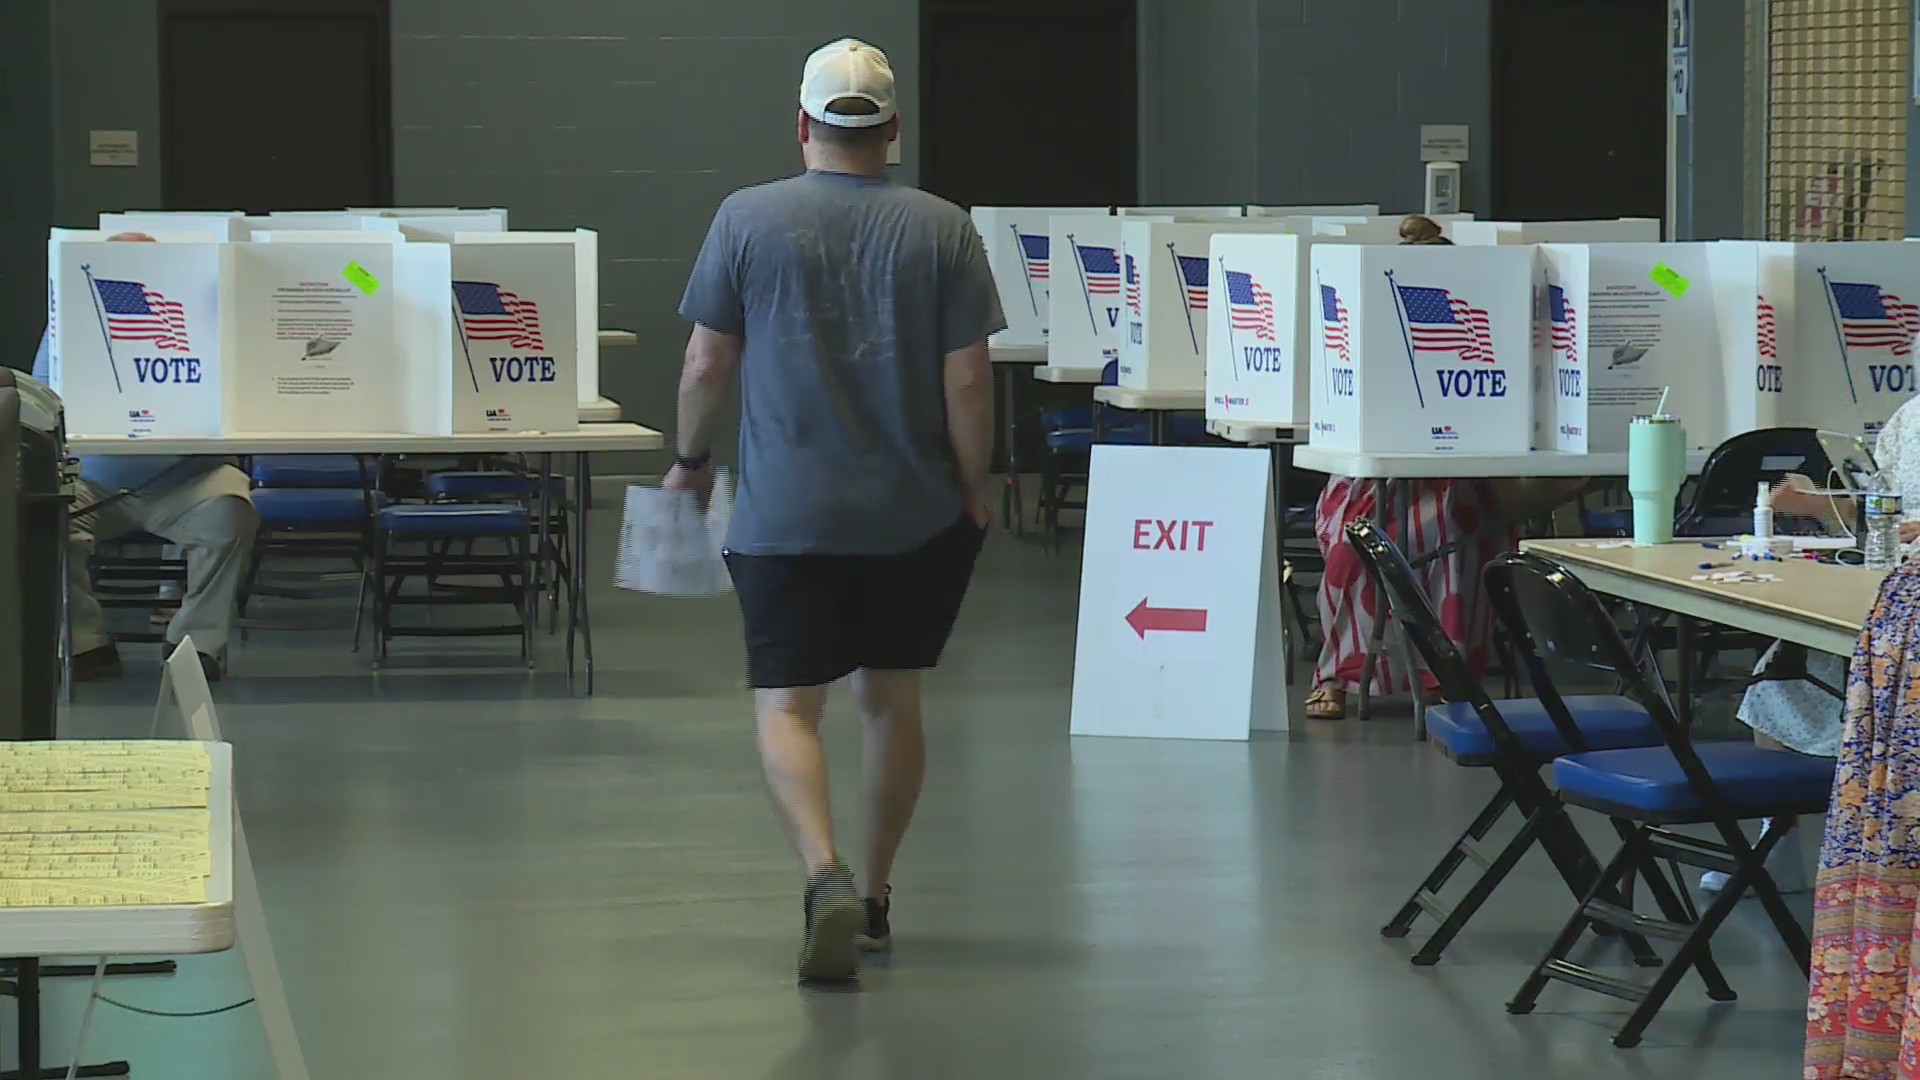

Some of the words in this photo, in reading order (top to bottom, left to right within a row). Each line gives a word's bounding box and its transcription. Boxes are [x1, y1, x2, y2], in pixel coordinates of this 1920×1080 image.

[133, 357, 202, 383] VOTE
[489, 356, 556, 382] VOTE
[1243, 346, 1282, 372] VOTE
[1332, 367, 1354, 396] VOTE
[1436, 369, 1507, 397] VOTE
[1558, 368, 1581, 397] VOTE
[1756, 364, 1783, 393] OTE
[1868, 364, 1917, 392] VOT
[1133, 519, 1214, 551] EXIT
